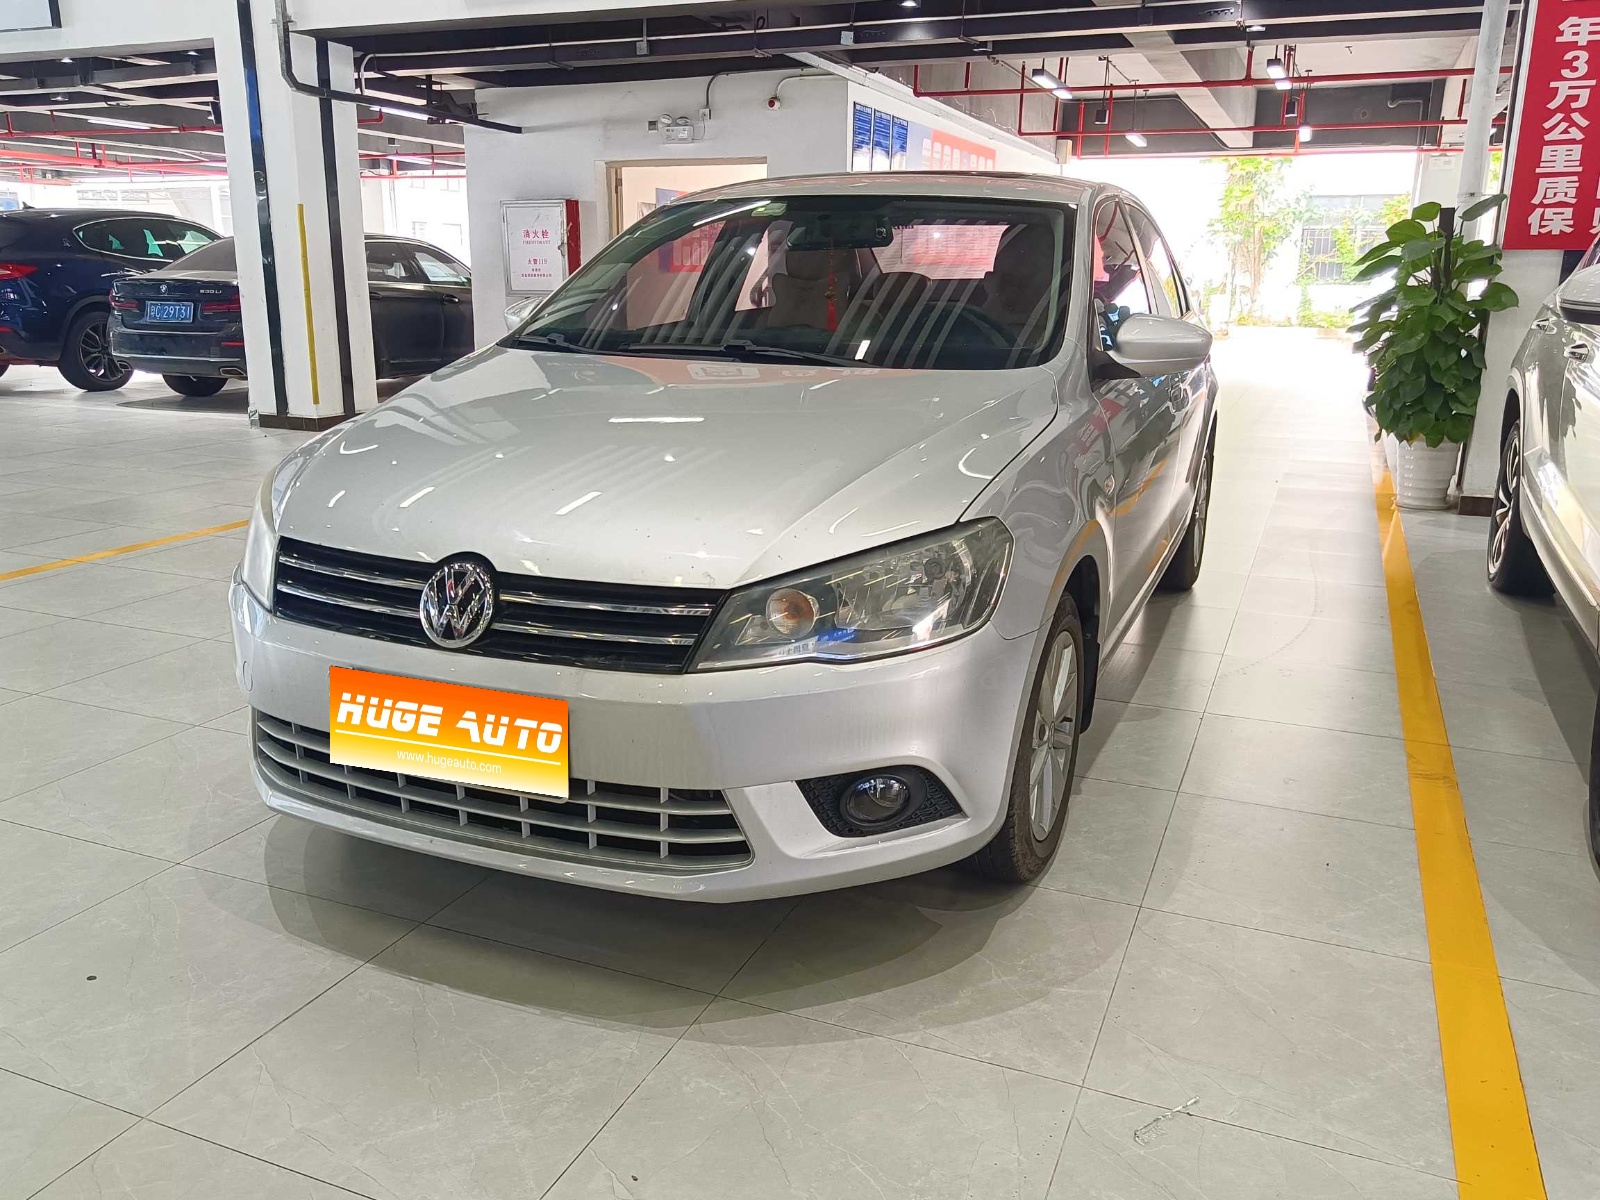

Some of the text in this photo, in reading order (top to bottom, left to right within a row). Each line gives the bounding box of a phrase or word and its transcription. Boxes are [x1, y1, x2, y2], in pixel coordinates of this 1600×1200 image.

[1527, 0, 1600, 236] 年3万公里质保
[522, 229, 549, 239] 消火栓
